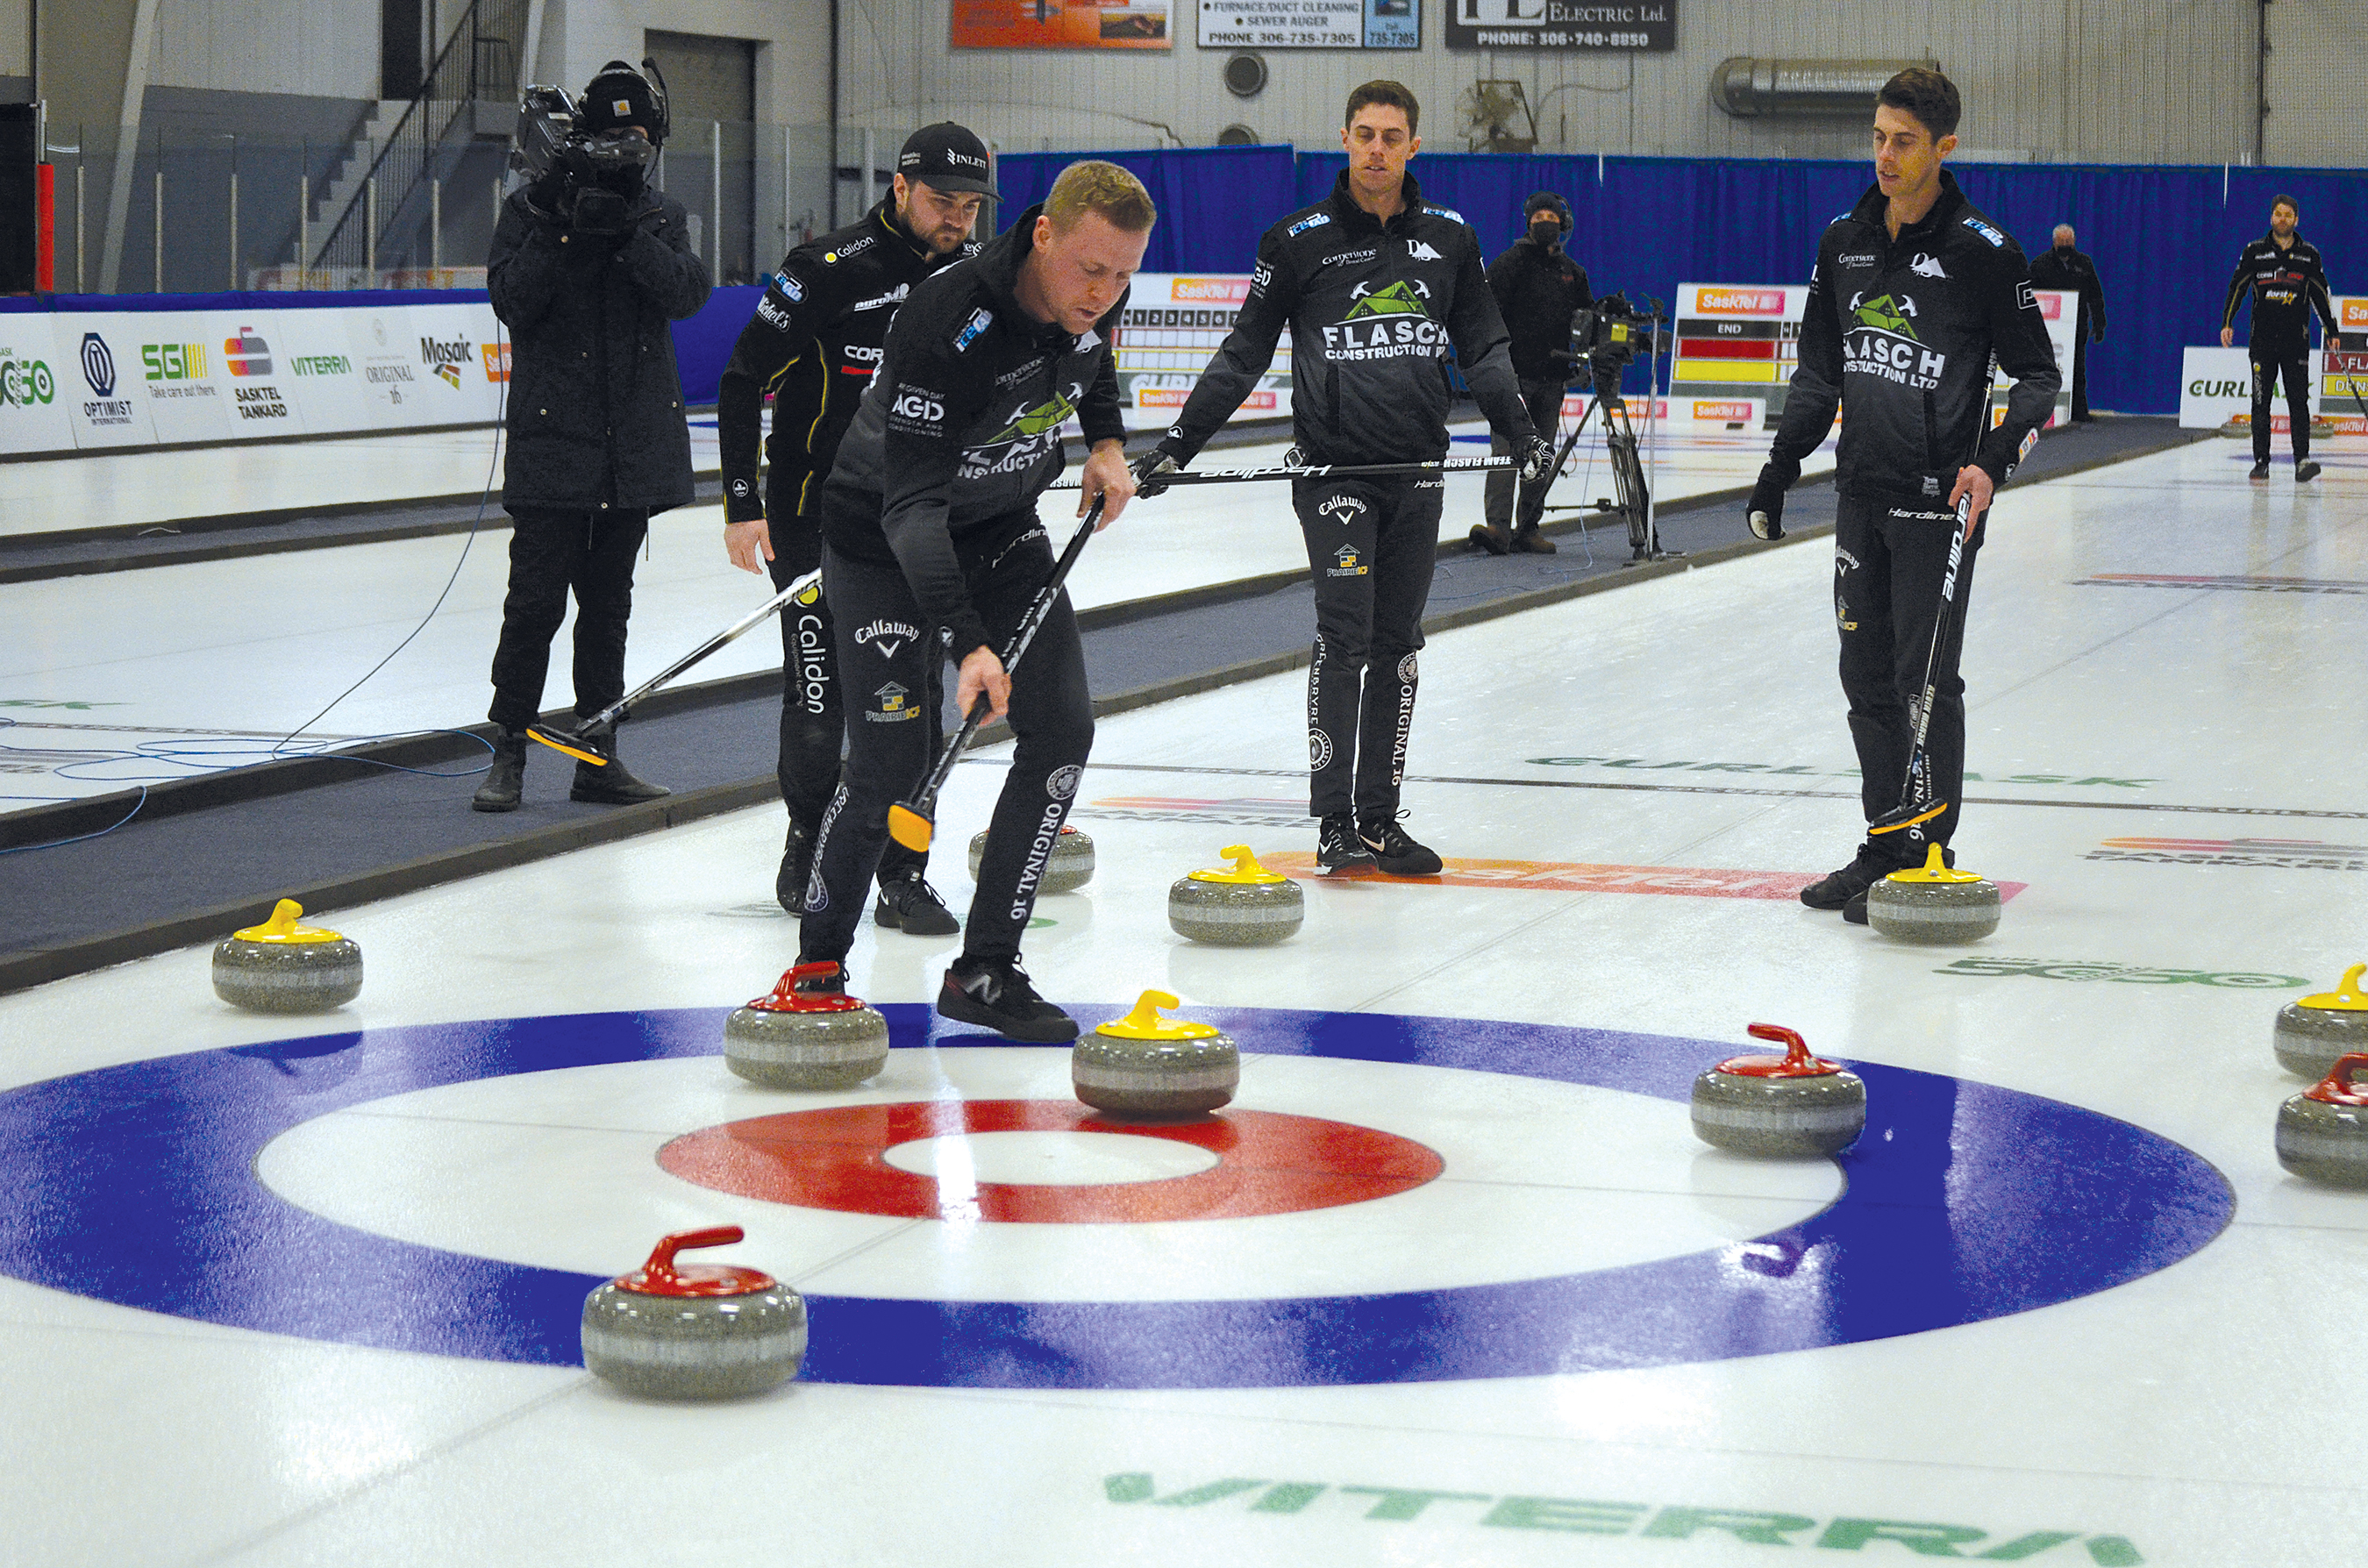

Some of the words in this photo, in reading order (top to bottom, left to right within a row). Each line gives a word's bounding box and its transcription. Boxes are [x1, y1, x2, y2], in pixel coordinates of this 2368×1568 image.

[1302, 3, 1359, 13] CLEANING
[1641, 5, 1667, 22] Ltd.
[1247, 17, 1287, 26] SEWER
[1290, 17, 1329, 26] AUGER
[1209, 32, 1254, 43] PHONE
[1259, 32, 1356, 44] 306-735-7305
[837, 236, 874, 258] Calidon
[1177, 283, 1230, 299] SaskTel
[1702, 294, 1758, 309] SaskTel
[1152, 314, 1159, 324] 2
[1169, 314, 1176, 324] 3
[1183, 314, 1191, 324] 4
[1200, 314, 1207, 324] 5
[1215, 314, 1223, 324] 6
[1717, 324, 1742, 334] END
[420, 332, 474, 364] Mosaic
[1324, 343, 1432, 361] CONSTRUCTION
[141, 343, 189, 381] SGI
[290, 355, 353, 376] VITERRA
[366, 365, 415, 383] ORIGINAL
[1909, 374, 1939, 390] LTD
[147, 384, 167, 398] Take
[167, 386, 182, 397] care
[184, 385, 196, 396] out
[196, 384, 217, 396] there
[234, 386, 282, 403] SASKTEL
[83, 400, 133, 417] OPTIMIST
[238, 403, 289, 420] TANKARD
[1443, 457, 1483, 468] FLASCH
[1318, 494, 1367, 516] Callaway
[1887, 507, 1956, 521] Hardline
[854, 618, 920, 645] Callaway
[798, 614, 831, 714] Calidon
[1392, 684, 1413, 766] ORIGINAL
[1916, 711, 1929, 747] MARSH
[1391, 768, 1402, 787] 16
[1016, 803, 1063, 895] ORIGINAL
[1009, 898, 1028, 921] 16
[1102, 1471, 2147, 1567] VITERRA
